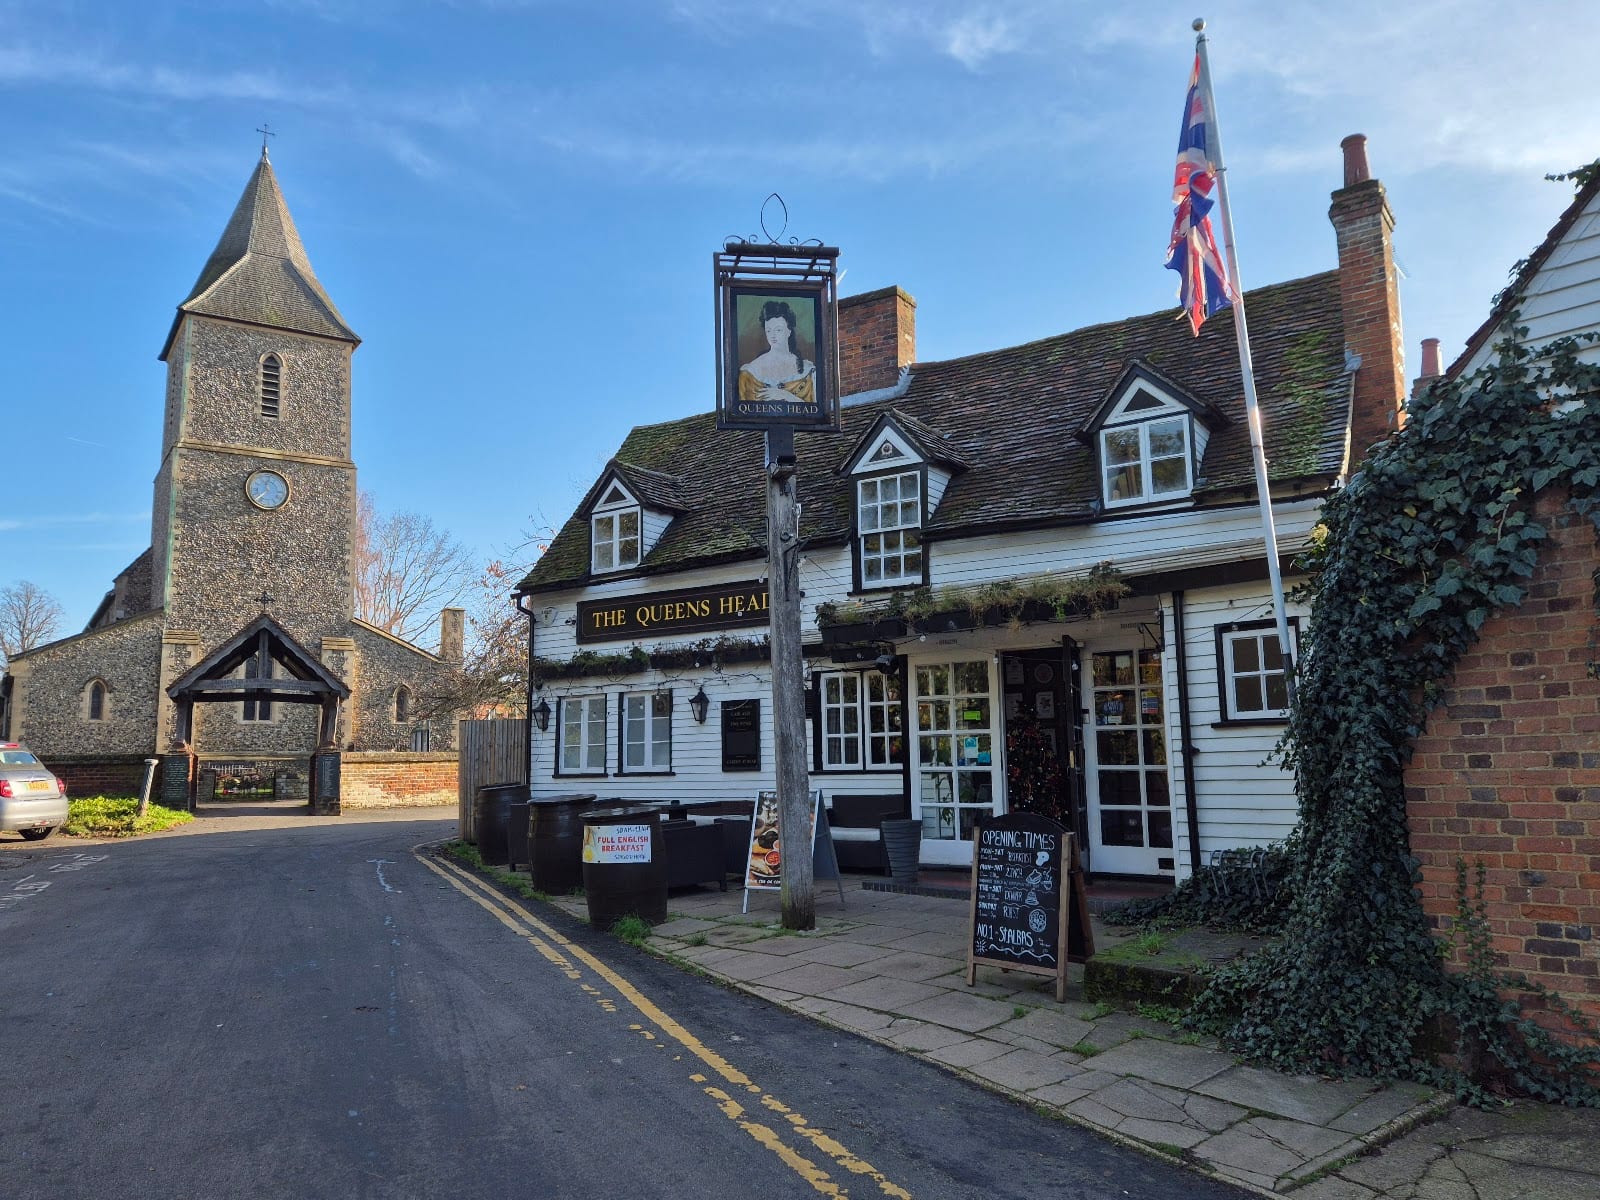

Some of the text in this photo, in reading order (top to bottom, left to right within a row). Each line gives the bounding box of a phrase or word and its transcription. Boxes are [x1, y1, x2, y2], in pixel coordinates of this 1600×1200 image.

[738, 403, 819, 414] QUEENS HEAD
[592, 609, 627, 628] THE
[636, 599, 711, 627] QUEENS
[597, 835, 649, 844] FULL ENGLISH
[982, 830, 1055, 850] OPENING TIMES
[601, 844, 645, 853] BREAKFAST
